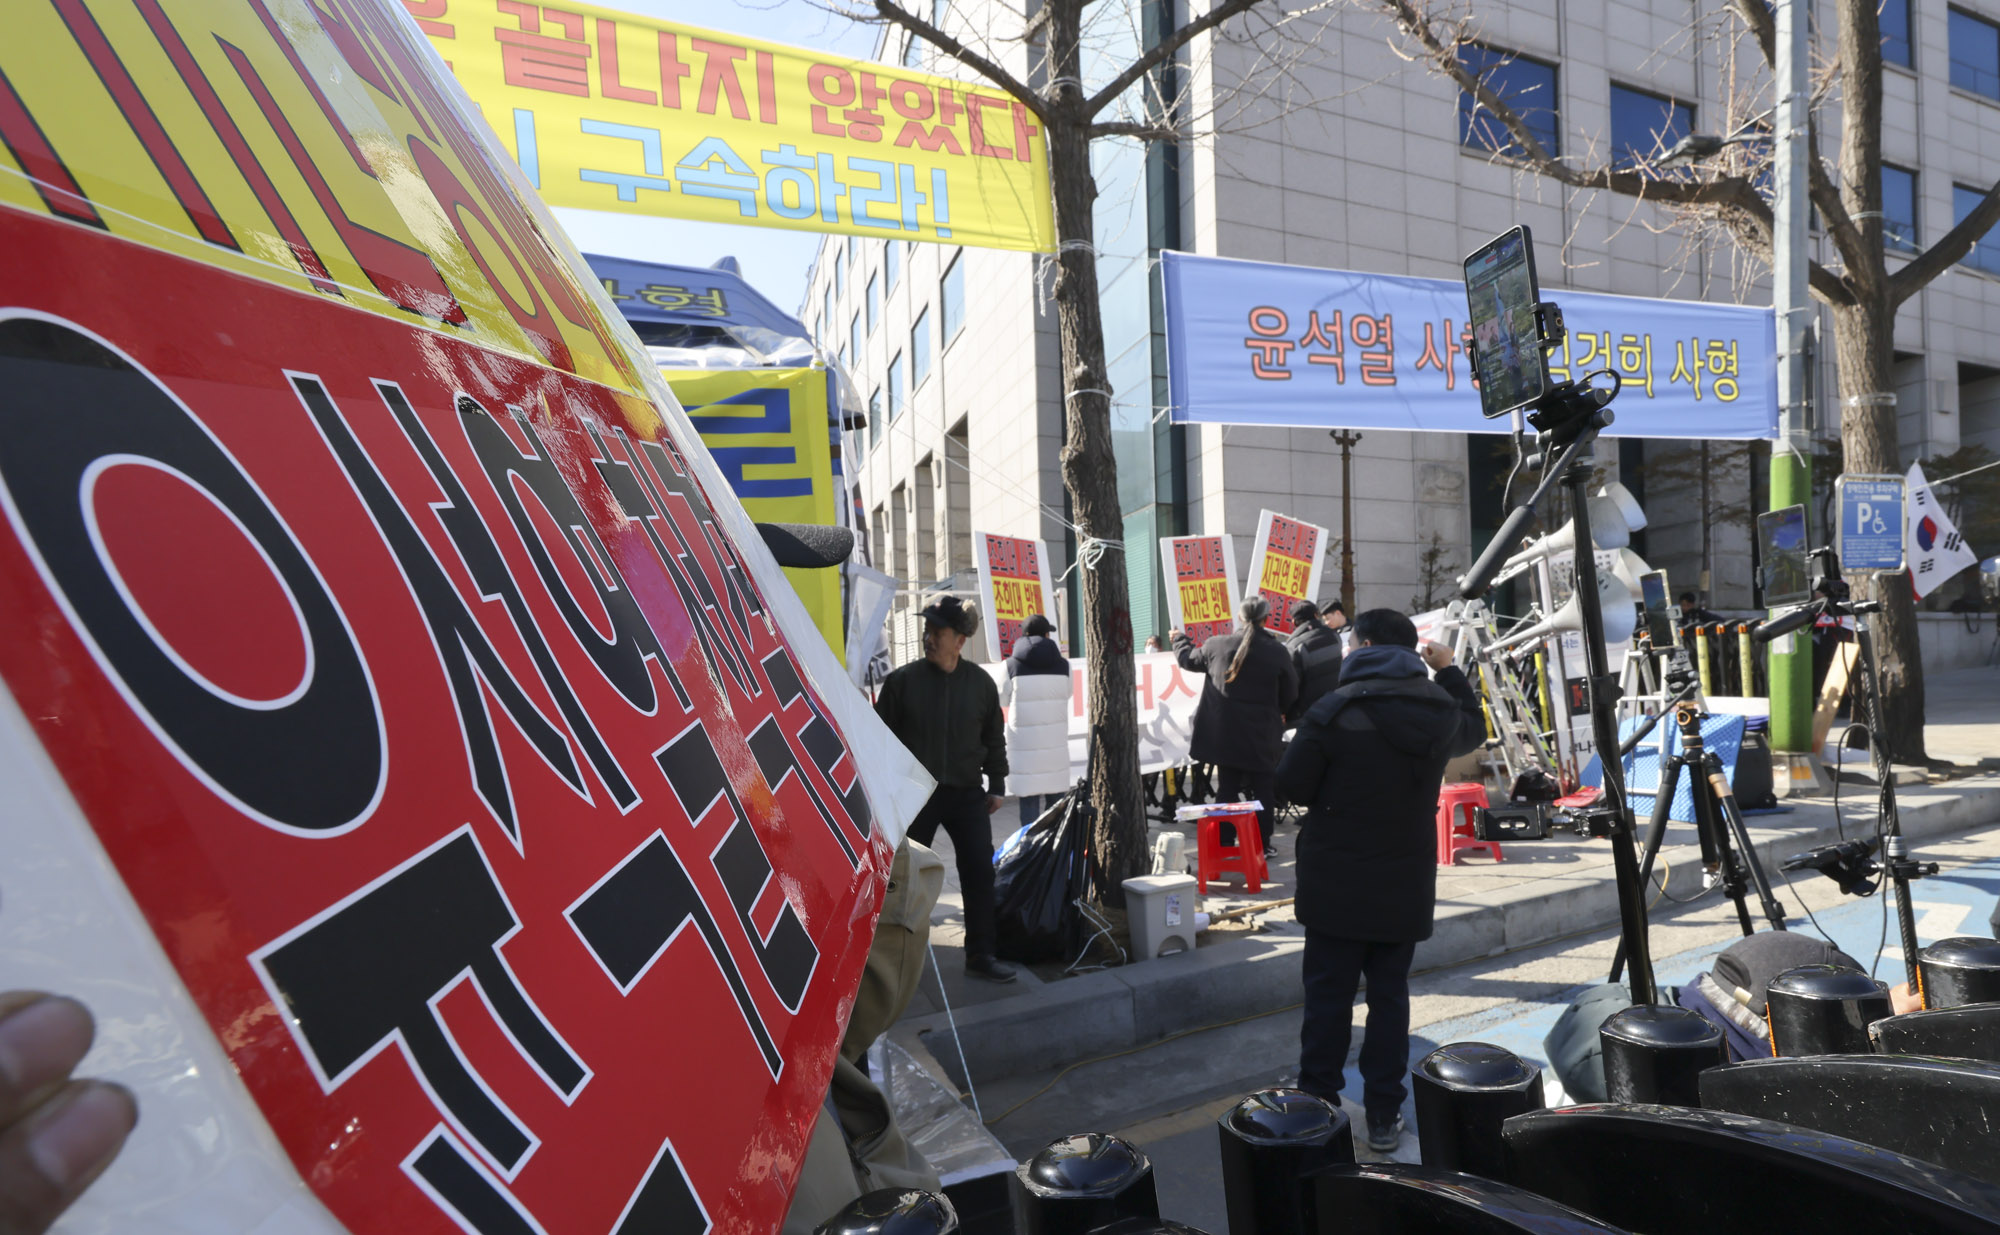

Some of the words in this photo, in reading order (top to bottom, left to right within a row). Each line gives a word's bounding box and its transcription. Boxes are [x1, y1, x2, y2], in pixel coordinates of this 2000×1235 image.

[495, 0, 777, 125] 끝나지
[807, 62, 1037, 163] 않았다
[579, 117, 953, 238] 구속하라!
[1245, 306, 1398, 387] 윤석열
[1415, 319, 1480, 391] 사
[1670, 338, 1740, 402] 사형
[1857, 502, 1873, 535] P
